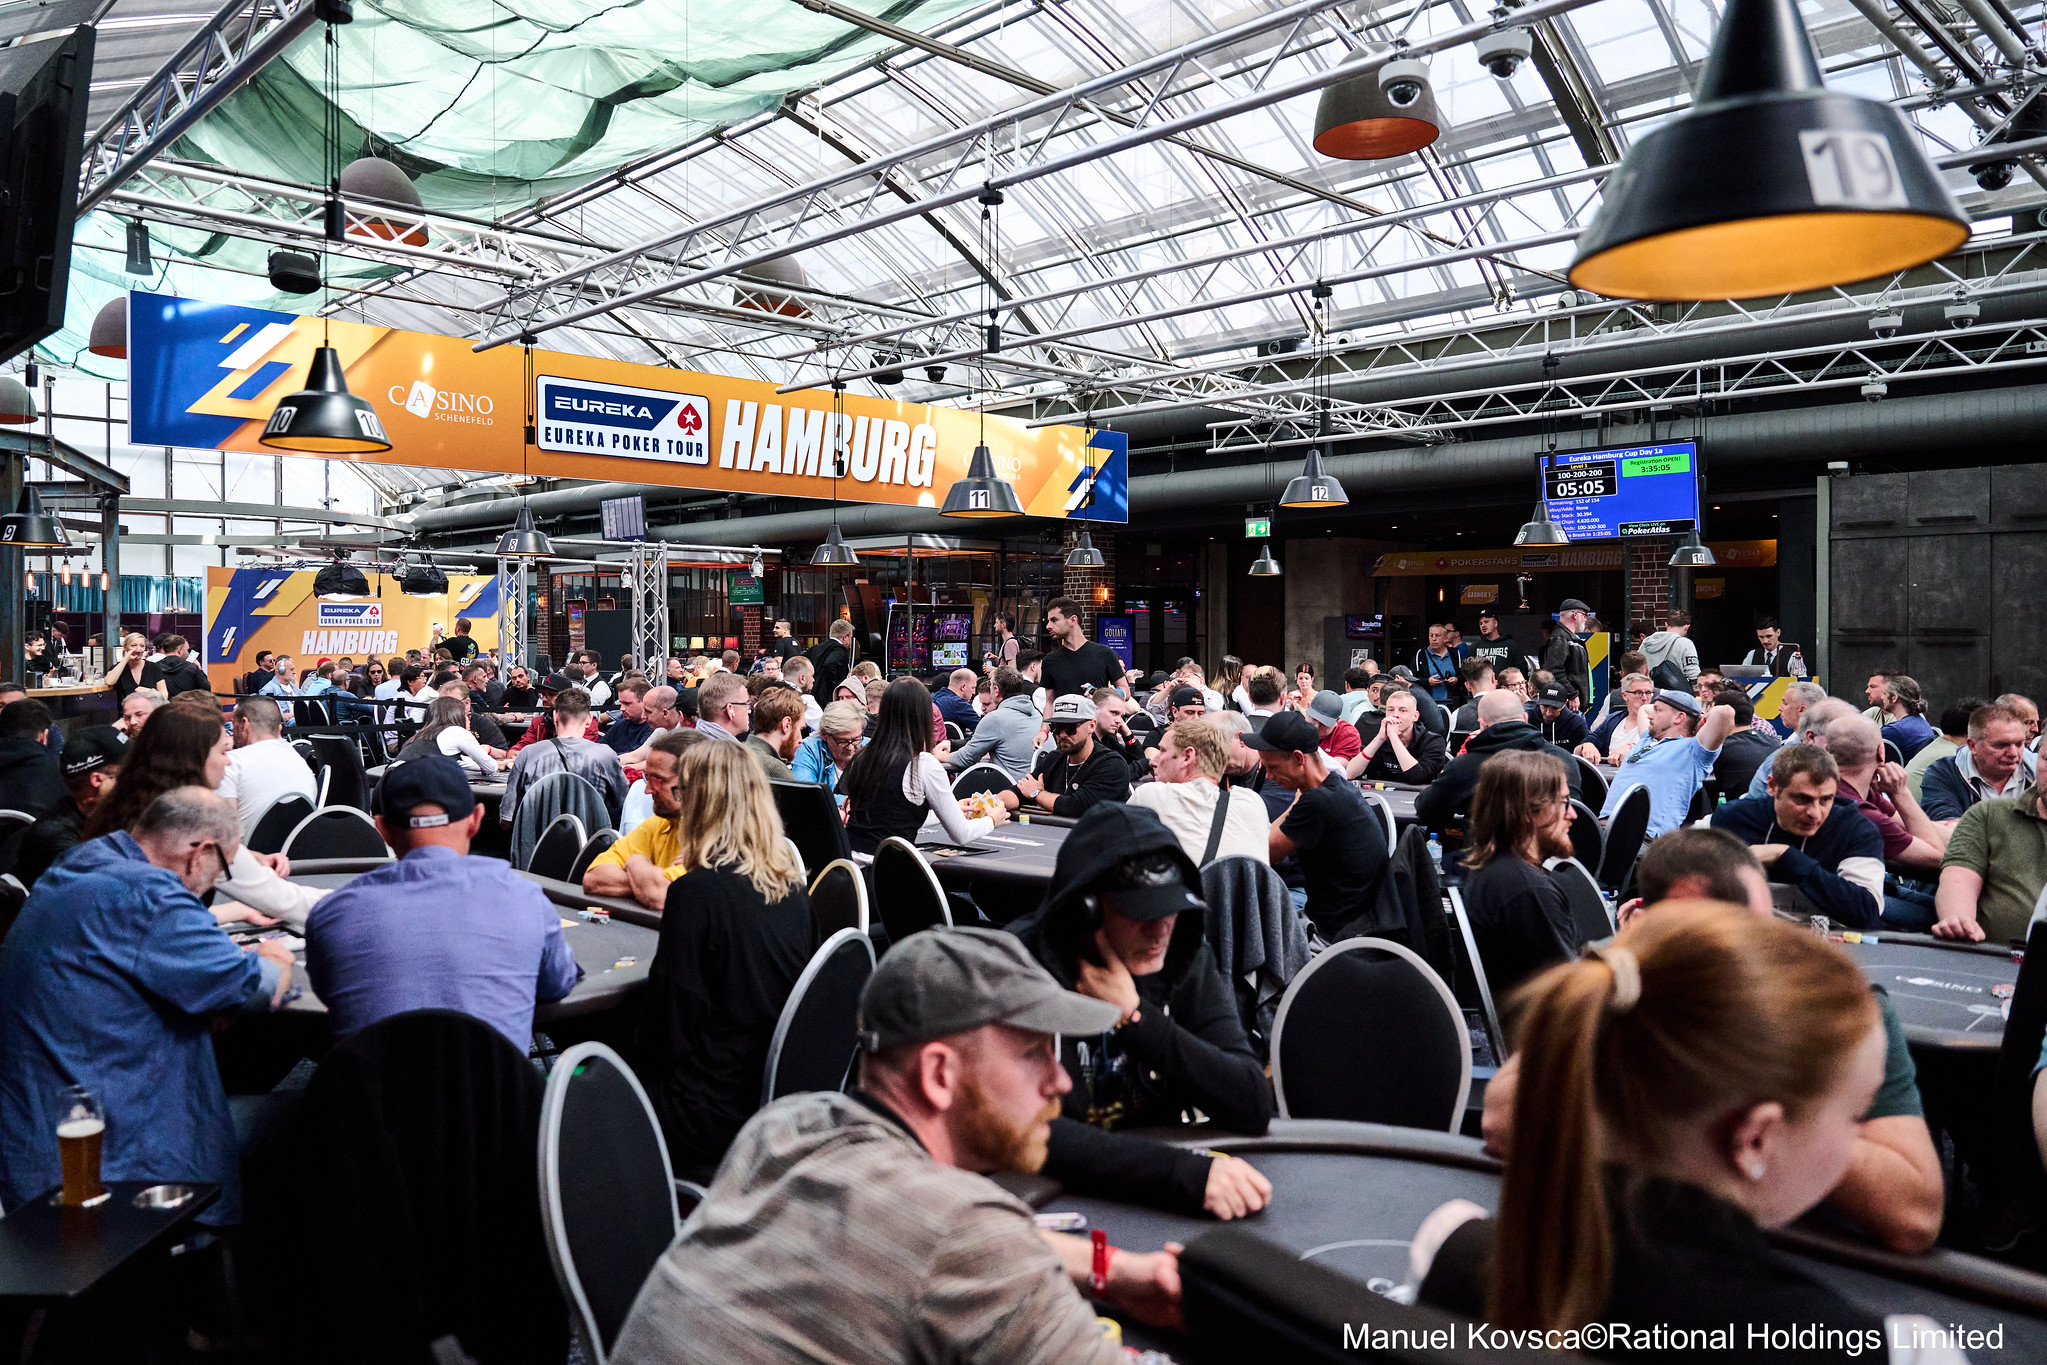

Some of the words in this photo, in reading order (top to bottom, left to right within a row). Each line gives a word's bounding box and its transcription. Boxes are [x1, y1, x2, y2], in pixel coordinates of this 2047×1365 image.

[1812, 137, 1895, 199] 19
[388, 383, 494, 416] CASINO
[554, 395, 654, 420] EUREKA
[271, 408, 292, 432] 10
[360, 413, 381, 437] 10
[434, 412, 494, 426] SCHENEFELD
[544, 426, 605, 448] EUREKA
[612, 433, 660, 453] POKER
[666, 439, 703, 458] TOUR
[718, 398, 938, 488] HAMBURG
[963, 451, 1021, 472] CSINO
[1592, 452, 1624, 460] Hamburg
[1624, 450, 1638, 458] Cup
[1630, 458, 1663, 466] Registration
[1557, 469, 1603, 480] 100-200-200
[1641, 464, 1671, 473] 3:35:05
[1313, 487, 1328, 500] 12
[1556, 480, 1605, 497] 05:05
[971, 490, 988, 508] 11
[4, 525, 14, 540] 9
[1628, 526, 1671, 535] PokerAtlas
[509, 539, 517, 550] 8
[824, 551, 830, 562] 7
[1451, 557, 1518, 567] POKERSTARS
[1560, 550, 1623, 567] HAMBURG
[1693, 554, 1704, 563] 14
[1104, 628, 1127, 638] GOLIATH
[300, 630, 399, 655] HAMBURG
[1489, 646, 1508, 658] ANGELS
